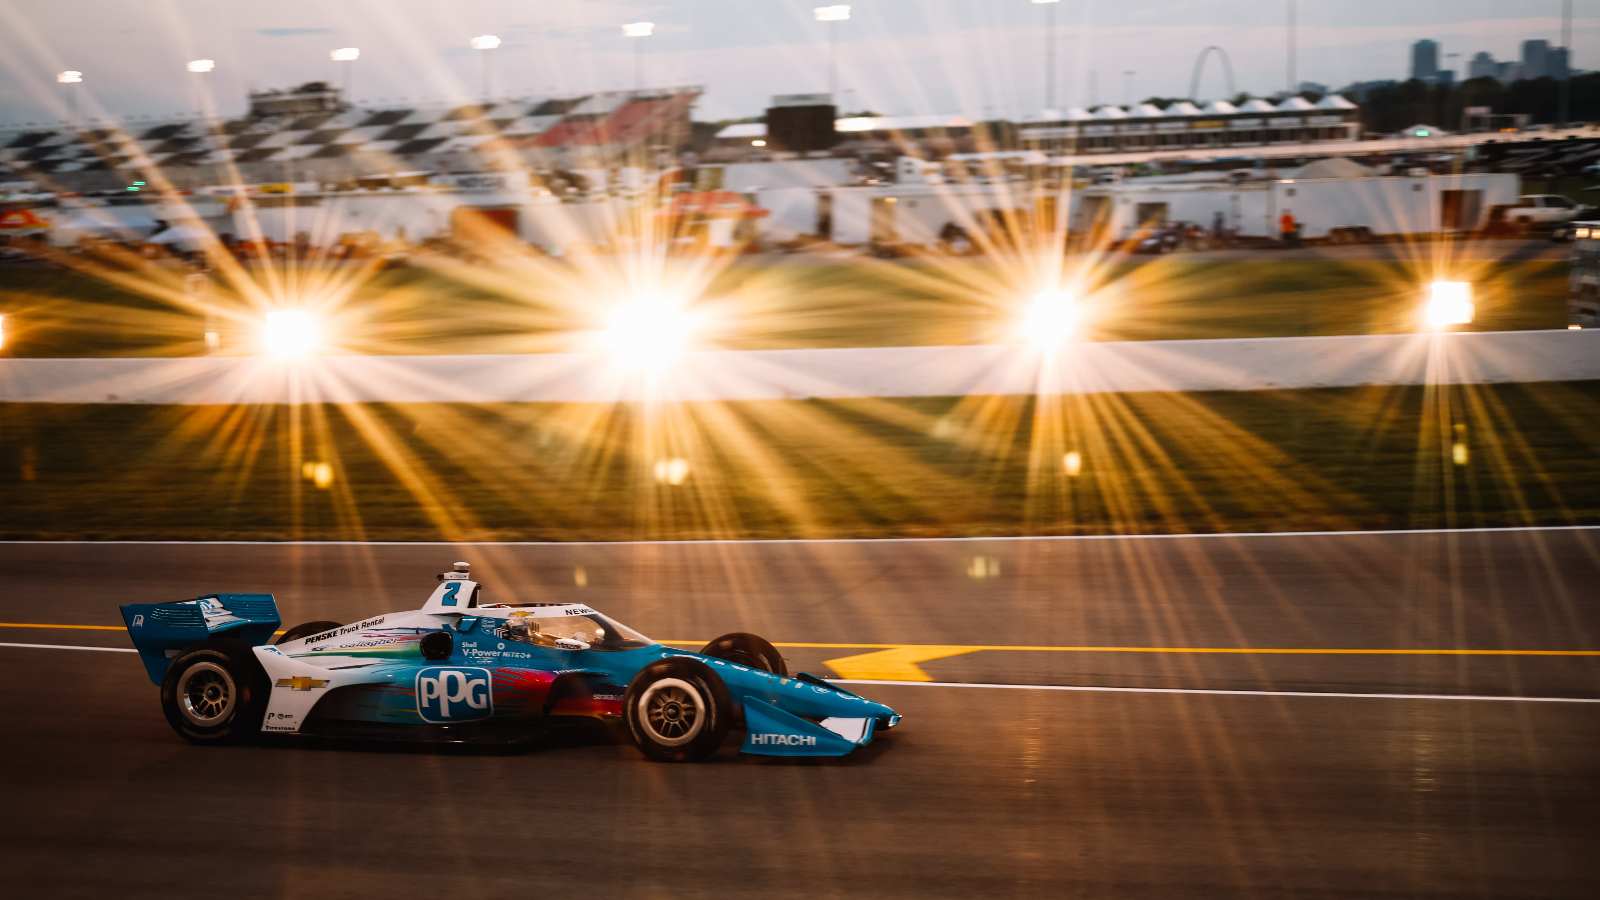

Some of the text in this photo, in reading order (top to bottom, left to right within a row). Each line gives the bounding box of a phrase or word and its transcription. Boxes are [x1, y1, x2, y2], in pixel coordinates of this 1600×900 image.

[441, 582, 461, 606] 2
[304, 616, 385, 646] PENSKE Truck Rental
[462, 649, 501, 658] V-Power
[751, 733, 817, 746] HITACHI
